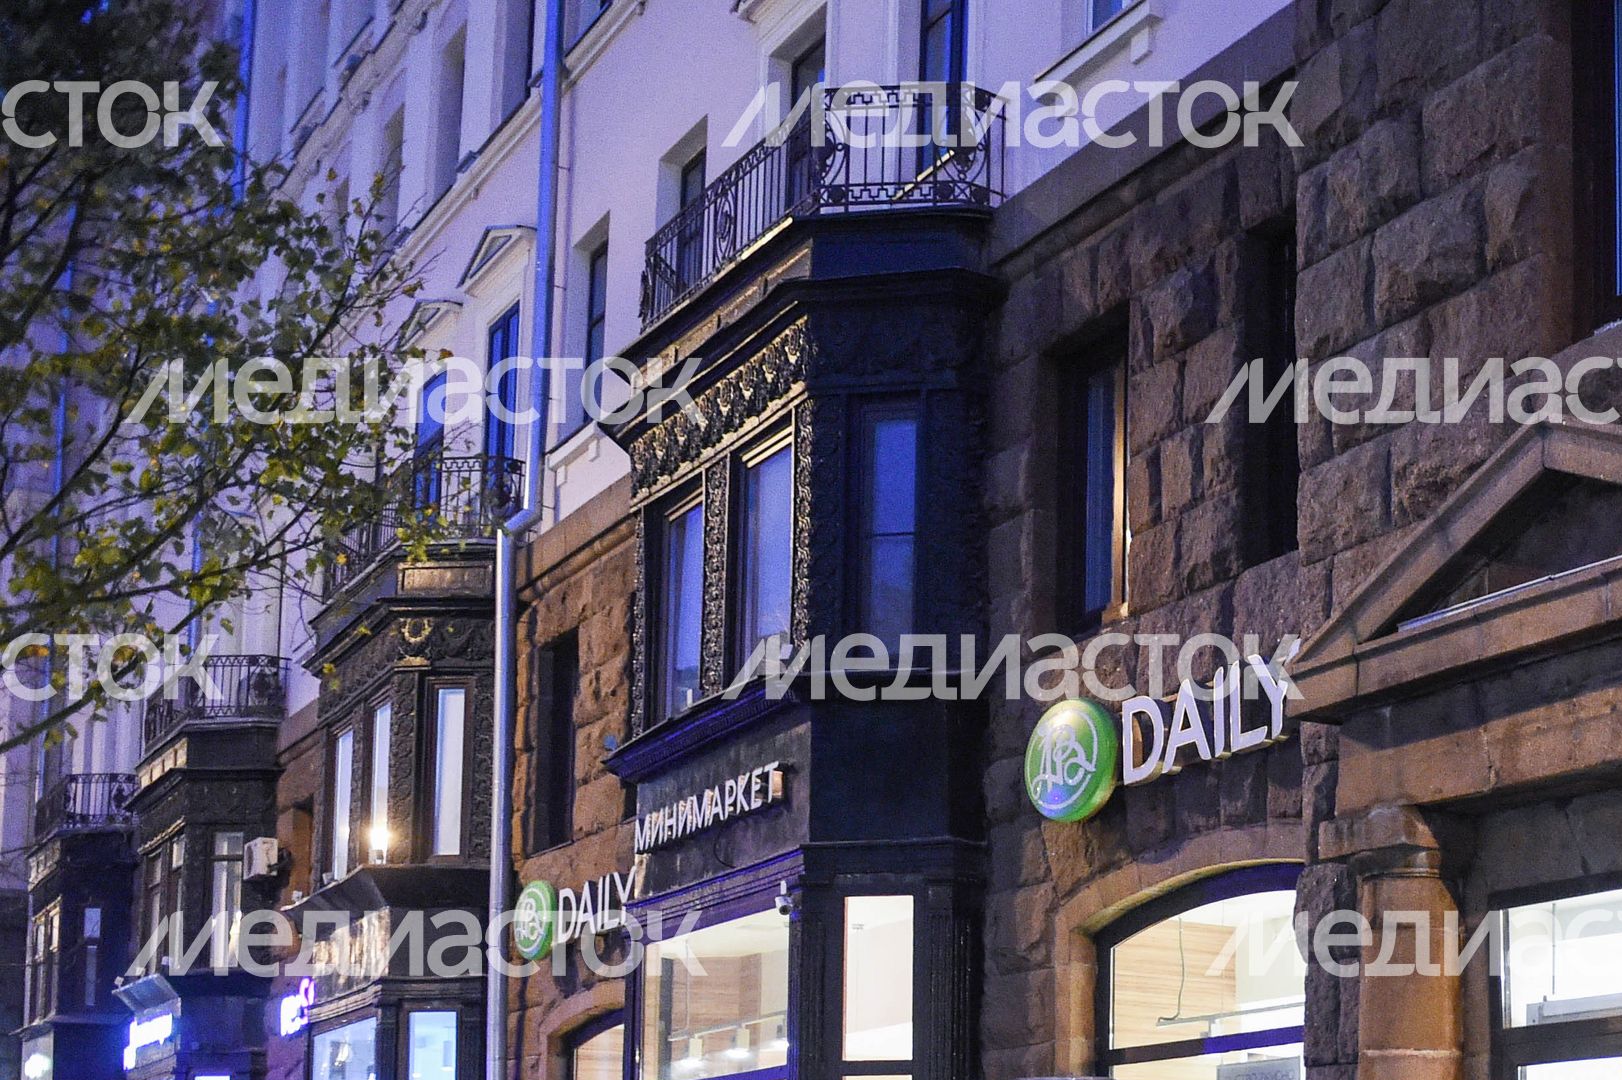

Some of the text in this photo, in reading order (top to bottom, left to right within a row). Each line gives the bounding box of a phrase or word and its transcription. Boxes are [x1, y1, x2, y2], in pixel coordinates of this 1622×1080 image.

[1122, 638, 1300, 785] DAILY
[635, 761, 779, 854] МИНИМАРКЕТ
[557, 865, 637, 944] DAILY
